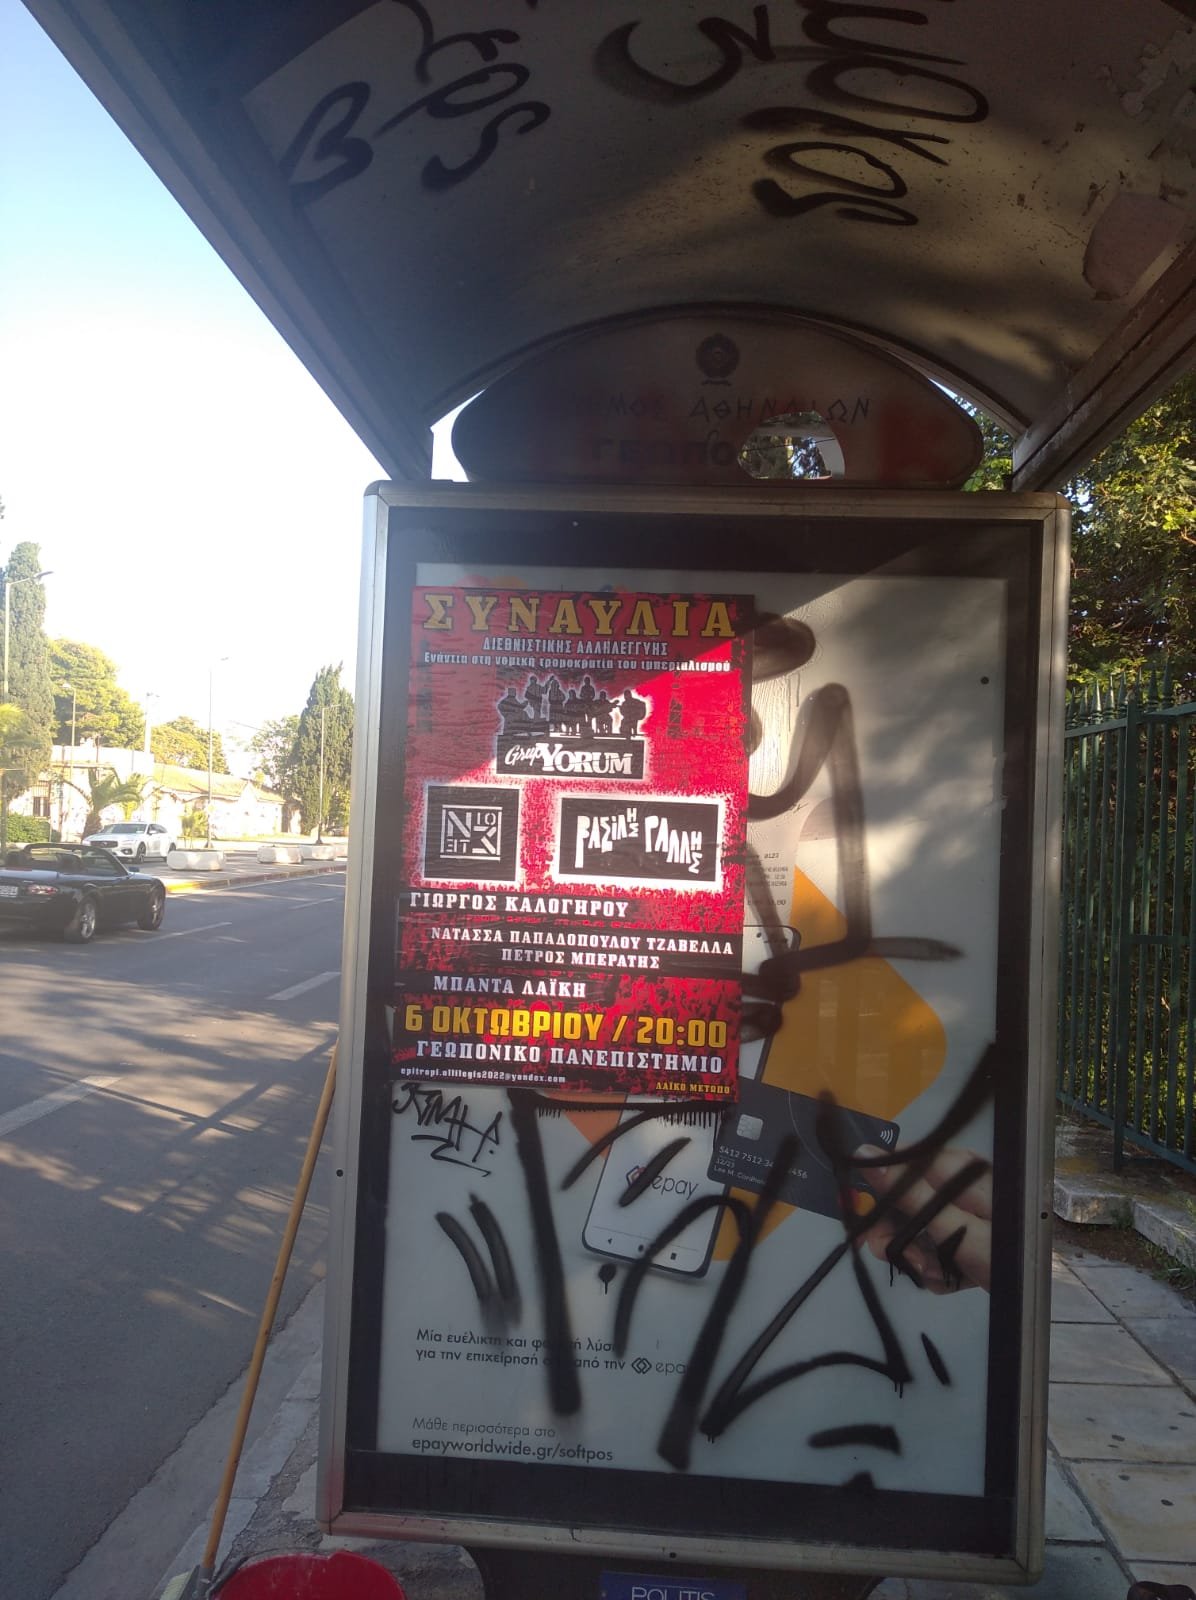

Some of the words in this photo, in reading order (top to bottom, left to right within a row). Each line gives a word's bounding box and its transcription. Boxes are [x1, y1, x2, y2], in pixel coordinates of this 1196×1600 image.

[423, 593, 736, 637] ΣΥΝΑΥΛΙΑ
[483, 637, 572, 654] ΔΙΕΘΝΙΣΤΙΚΗΣ
[576, 640, 668, 656] ΑΛΛΗΛΕΓΓΥΗΣ
[424, 652, 468, 665] Ενάντια
[471, 655, 491, 666] στη
[495, 655, 535, 668] νομική
[618, 659, 637, 670] του
[641, 660, 731, 672] ιμπεριαλισμού
[536, 743, 633, 774] YORUM
[410, 892, 497, 911] ΓΙΩΡΓΟΣ
[505, 897, 629, 917] ΚΑΛΟΓΗΡΟΥ
[431, 927, 502, 943] ΝΑΤΑΣΣΑ
[510, 931, 641, 950] ΠΑΠΑΔΟΠΟΥΛΟΥ
[647, 938, 734, 955] ΤΖΑΒΕΛΛΑ
[501, 949, 565, 965] ΠΕΤΡΟΣ
[571, 952, 660, 968] ΜΠΕΡΑΤΗΣ
[434, 976, 513, 993] ΜΠΑΝΤΑ
[522, 979, 587, 997] ΛΑΪΚΗ
[405, 1004, 423, 1032] 6
[432, 1006, 604, 1041] ΟΚΤΩΒΡΙΟΥ
[611, 1016, 628, 1042] /
[636, 1016, 728, 1048] 20:00
[416, 1040, 541, 1063] ΓΕΩΠΟΝΙΚΟ
[550, 1048, 723, 1074] ΠΑΝΕΠΙΣΤΗΜΙΟ
[690, 1083, 730, 1094] ΜΕΤΩΠΟ
[652, 1175, 699, 1200] epay
[416, 1328, 442, 1343] Μία
[507, 1334, 526, 1349] και
[587, 1338, 622, 1353] λύσ
[416, 1349, 436, 1365] για
[441, 1351, 461, 1362] την
[466, 1351, 538, 1368] επιχείρησή
[605, 1360, 626, 1370] την
[655, 1363, 692, 1375] epa
[412, 1417, 448, 1431] Μάθε
[452, 1420, 530, 1438] περισσότερα
[535, 1427, 556, 1438] στο
[412, 1437, 614, 1462] epayworldwide.gr/softpos
